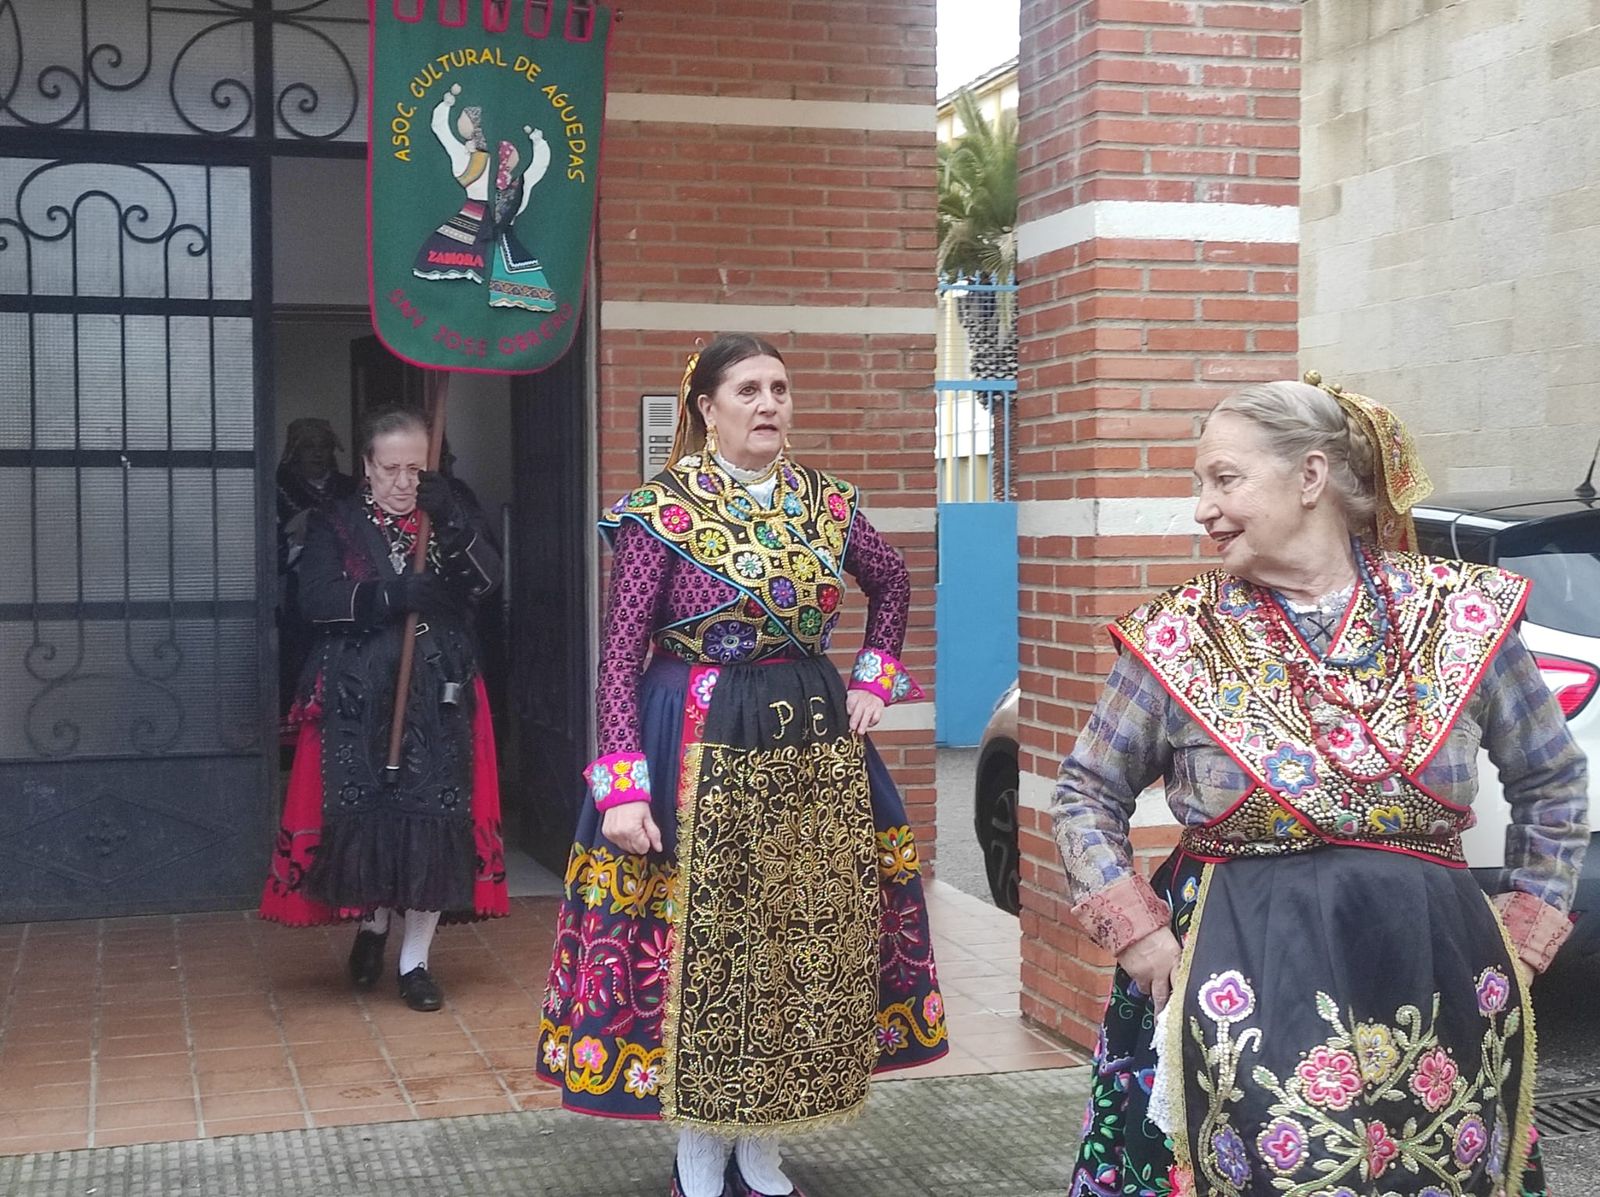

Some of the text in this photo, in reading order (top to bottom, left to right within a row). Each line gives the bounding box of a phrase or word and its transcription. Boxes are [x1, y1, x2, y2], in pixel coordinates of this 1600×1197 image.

[410, 48, 508, 98] CULTURAL
[513, 55, 542, 83] DE
[541, 83, 587, 183] AGUEDAS
[427, 250, 485, 268] ZAMORA
[498, 303, 574, 356] OBRERO
